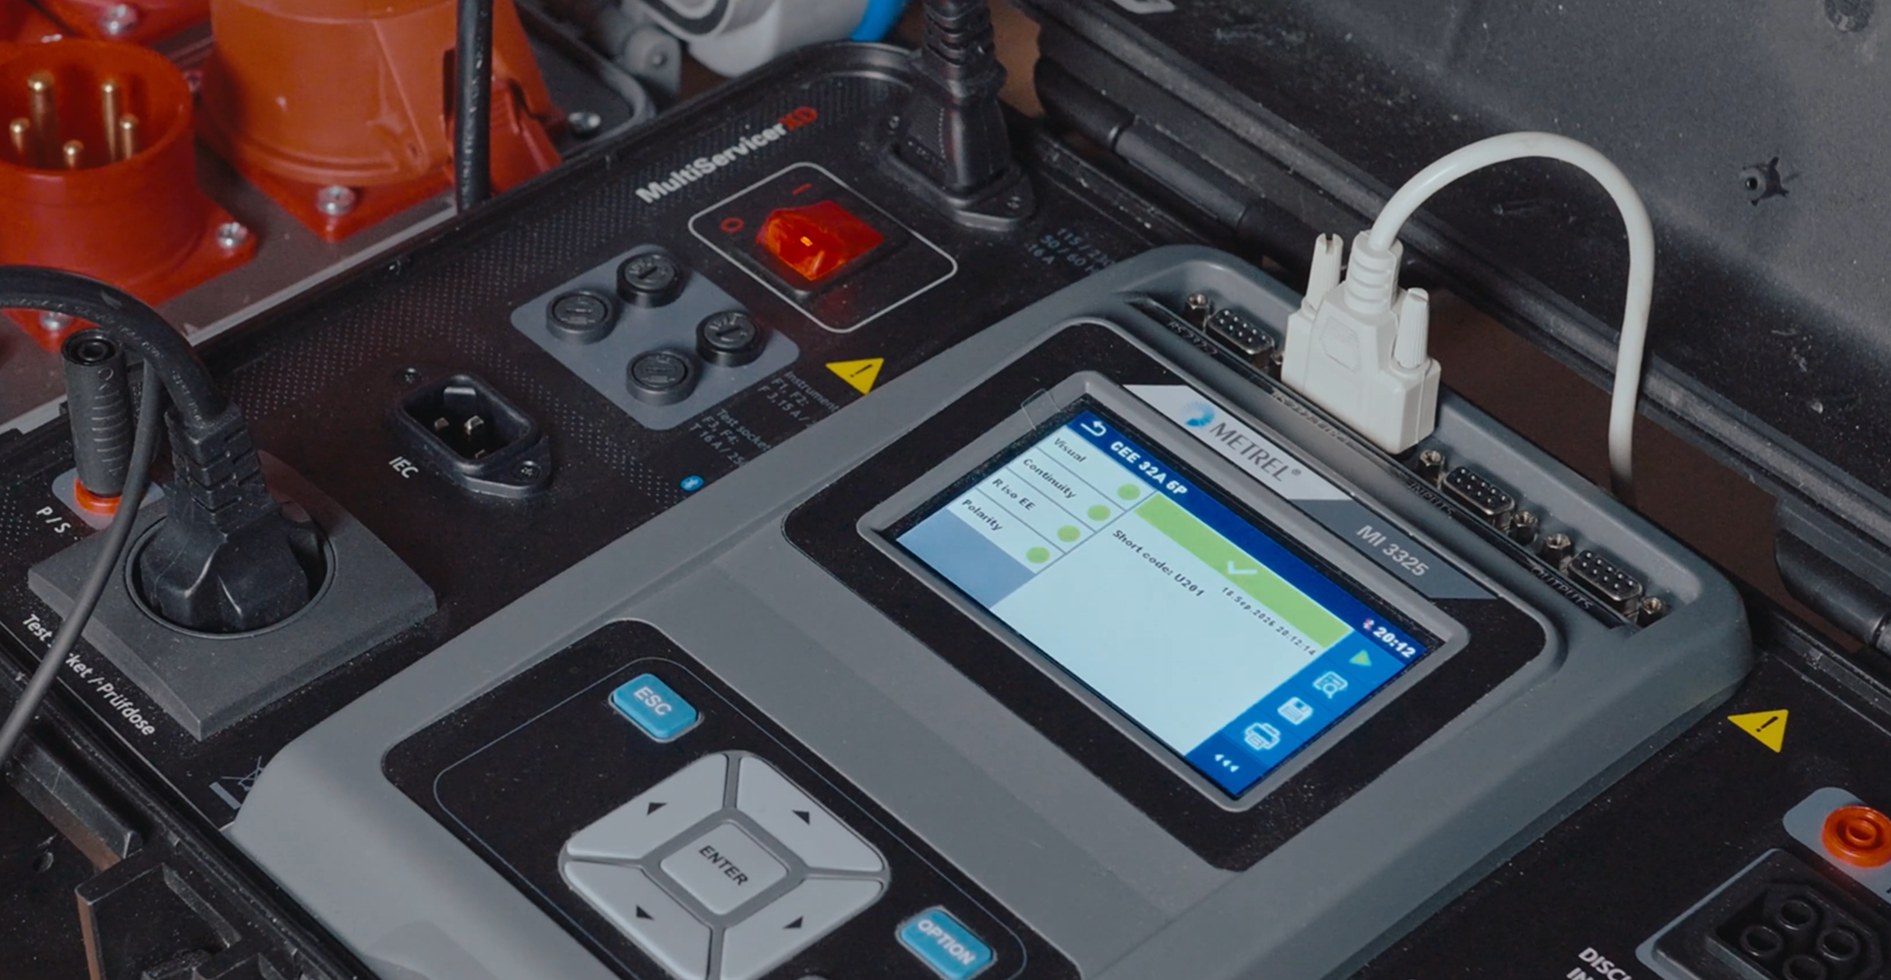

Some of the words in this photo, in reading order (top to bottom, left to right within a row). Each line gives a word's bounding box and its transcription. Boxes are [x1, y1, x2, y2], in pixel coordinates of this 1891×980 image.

[716, 408, 739, 427] Test
[388, 456, 419, 479] IEC
[1053, 437, 1087, 463] Visual
[1109, 440, 1141, 464] CEE
[1138, 461, 1167, 485] 32A
[1166, 480, 1188, 496] 6P
[992, 478, 1004, 488] R
[1001, 484, 1018, 500] iso
[1019, 497, 1037, 511] EE
[1023, 458, 1077, 499] Continuity
[36, 505, 52, 517] P
[46, 515, 62, 524] /
[54, 521, 72, 534] S
[961, 498, 1003, 532] Polarity
[1112, 529, 1142, 554] Short
[1142, 550, 1174, 576] code:
[1174, 573, 1205, 597] U201
[1356, 524, 1386, 547] MI
[1381, 541, 1430, 578] 3325
[1529, 564, 1595, 610] OUTPUTS
[1373, 626, 1417, 659] 20:12
[22, 614, 52, 642] Test
[96, 681, 156, 736] Prüfdose
[633, 685, 673, 717] ESC
[699, 844, 748, 886] ENTER
[917, 917, 976, 966] OPTION
